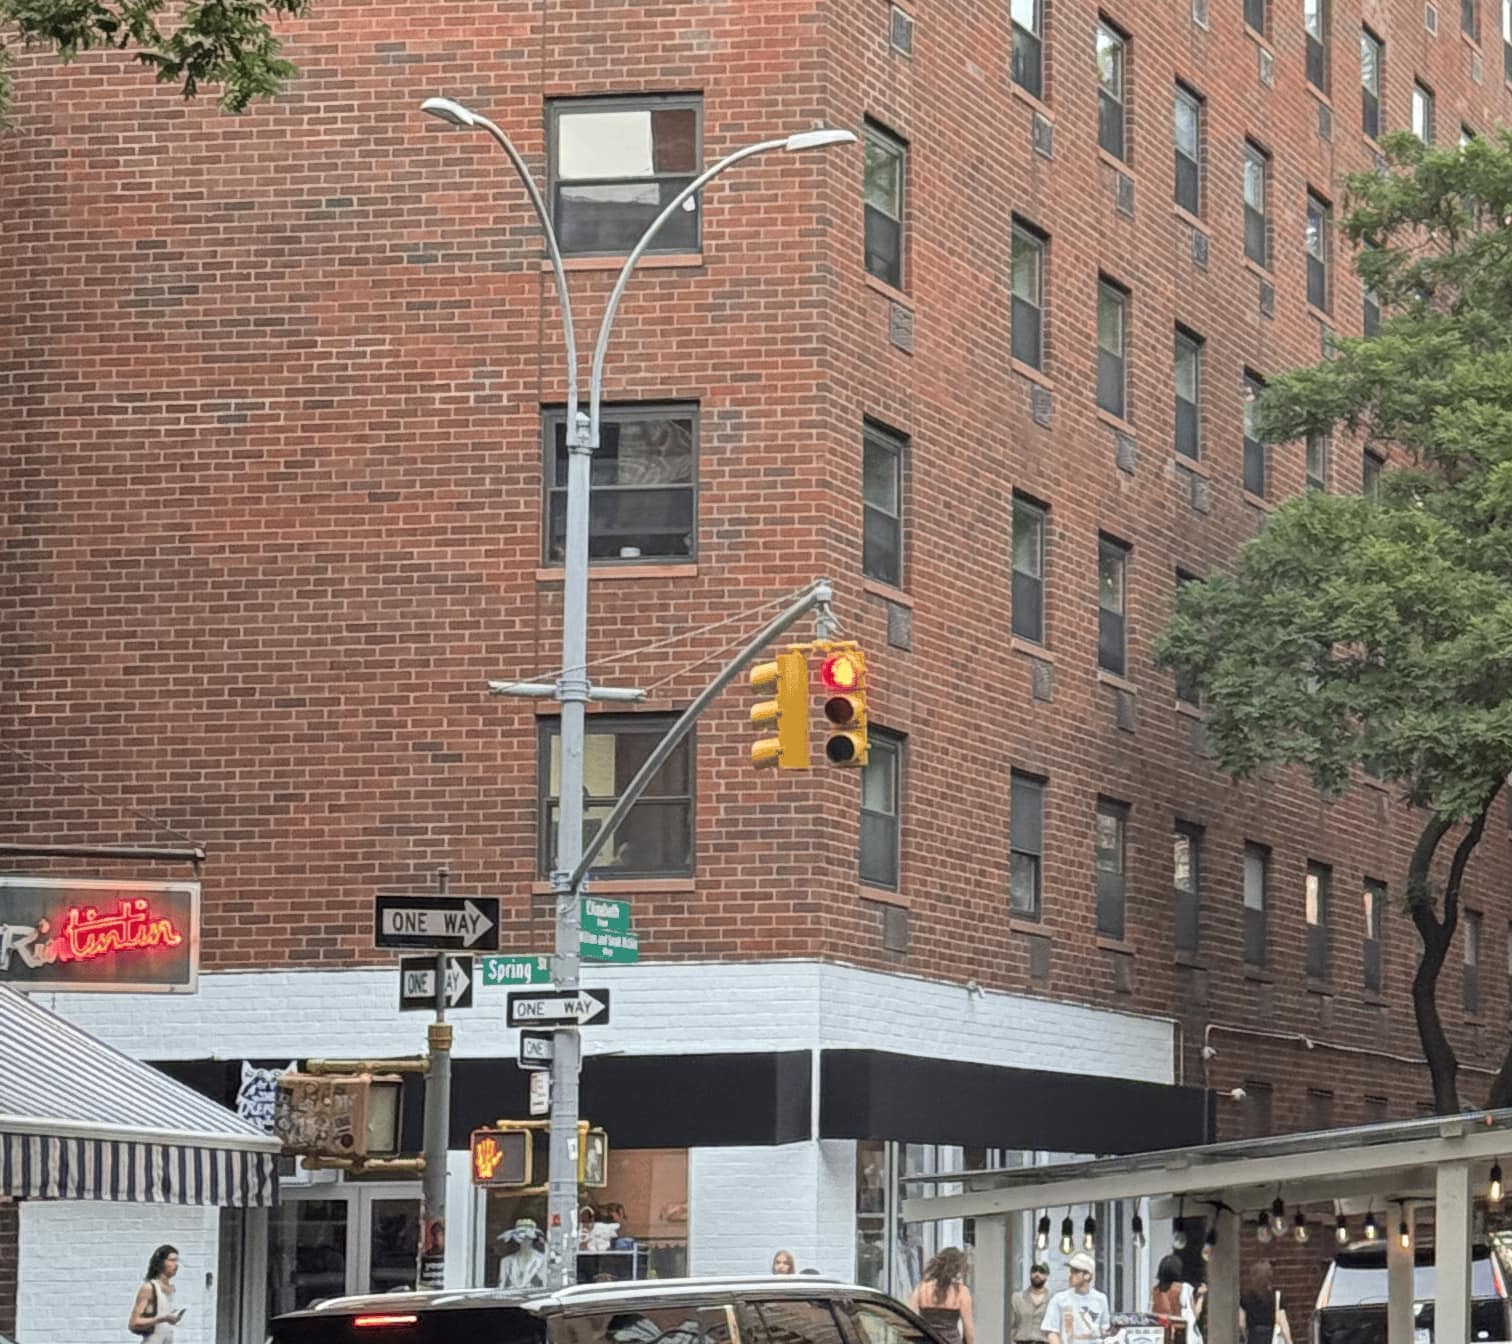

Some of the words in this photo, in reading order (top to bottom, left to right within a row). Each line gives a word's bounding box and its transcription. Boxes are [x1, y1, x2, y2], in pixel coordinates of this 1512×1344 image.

[392, 912, 428, 933] ONE
[444, 913, 481, 935] WAY
[488, 959, 532, 984] Spring
[537, 956, 548, 971] St
[407, 973, 428, 994] ONE
[444, 972, 460, 992] AY
[517, 1001, 545, 1016] ONE
[563, 1000, 592, 1015] WAY
[526, 1040, 543, 1055] ONE
